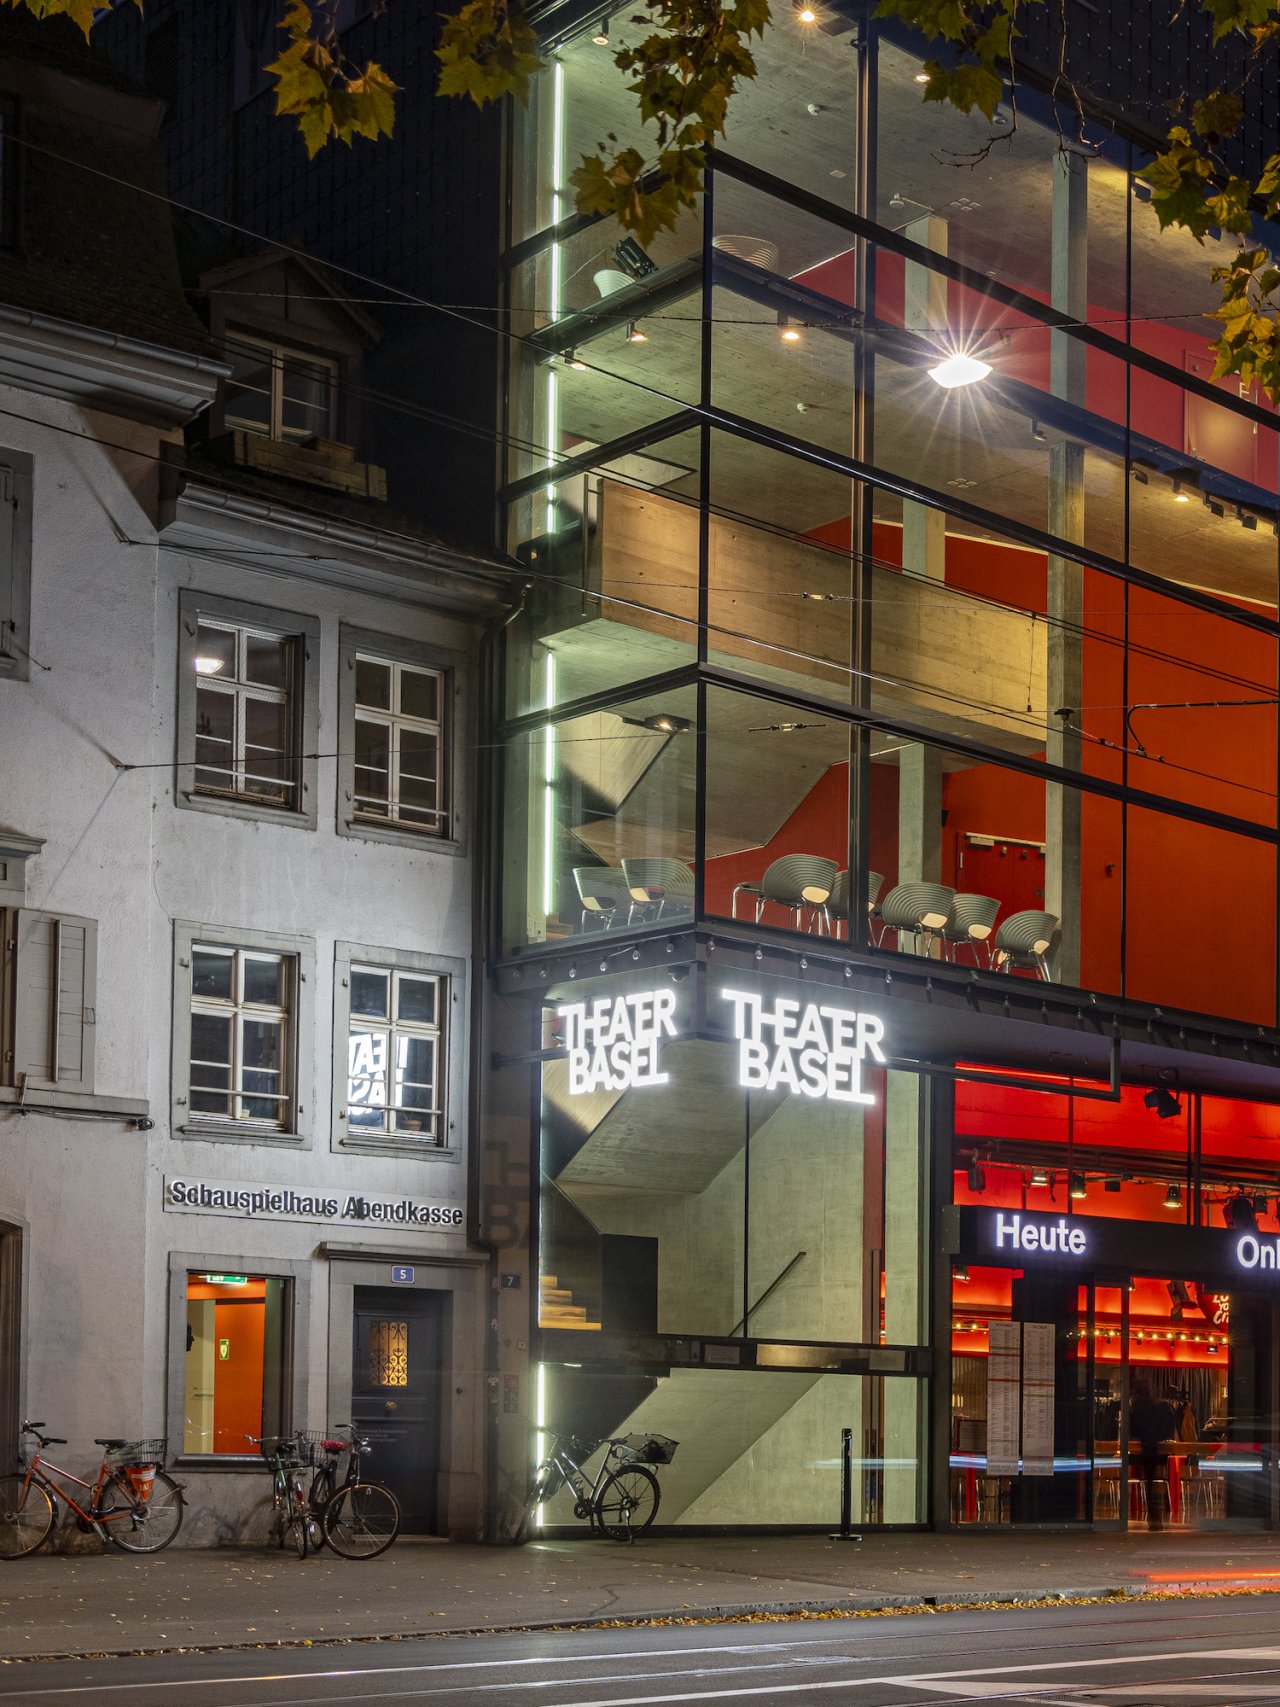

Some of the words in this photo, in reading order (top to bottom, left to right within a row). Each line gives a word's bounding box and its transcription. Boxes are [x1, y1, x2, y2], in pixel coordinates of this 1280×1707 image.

[558, 989, 677, 1051] THEATER
[722, 989, 886, 1062] THEATER
[569, 1037, 669, 1095] BASEL
[739, 1038, 875, 1104] BASEL
[171, 1181, 338, 1216] Schauspielhaus
[344, 1196, 463, 1225] Abendkasse
[996, 1213, 1086, 1254] Heute
[400, 1269, 407, 1280] 5
[507, 1276, 514, 1286] 7
